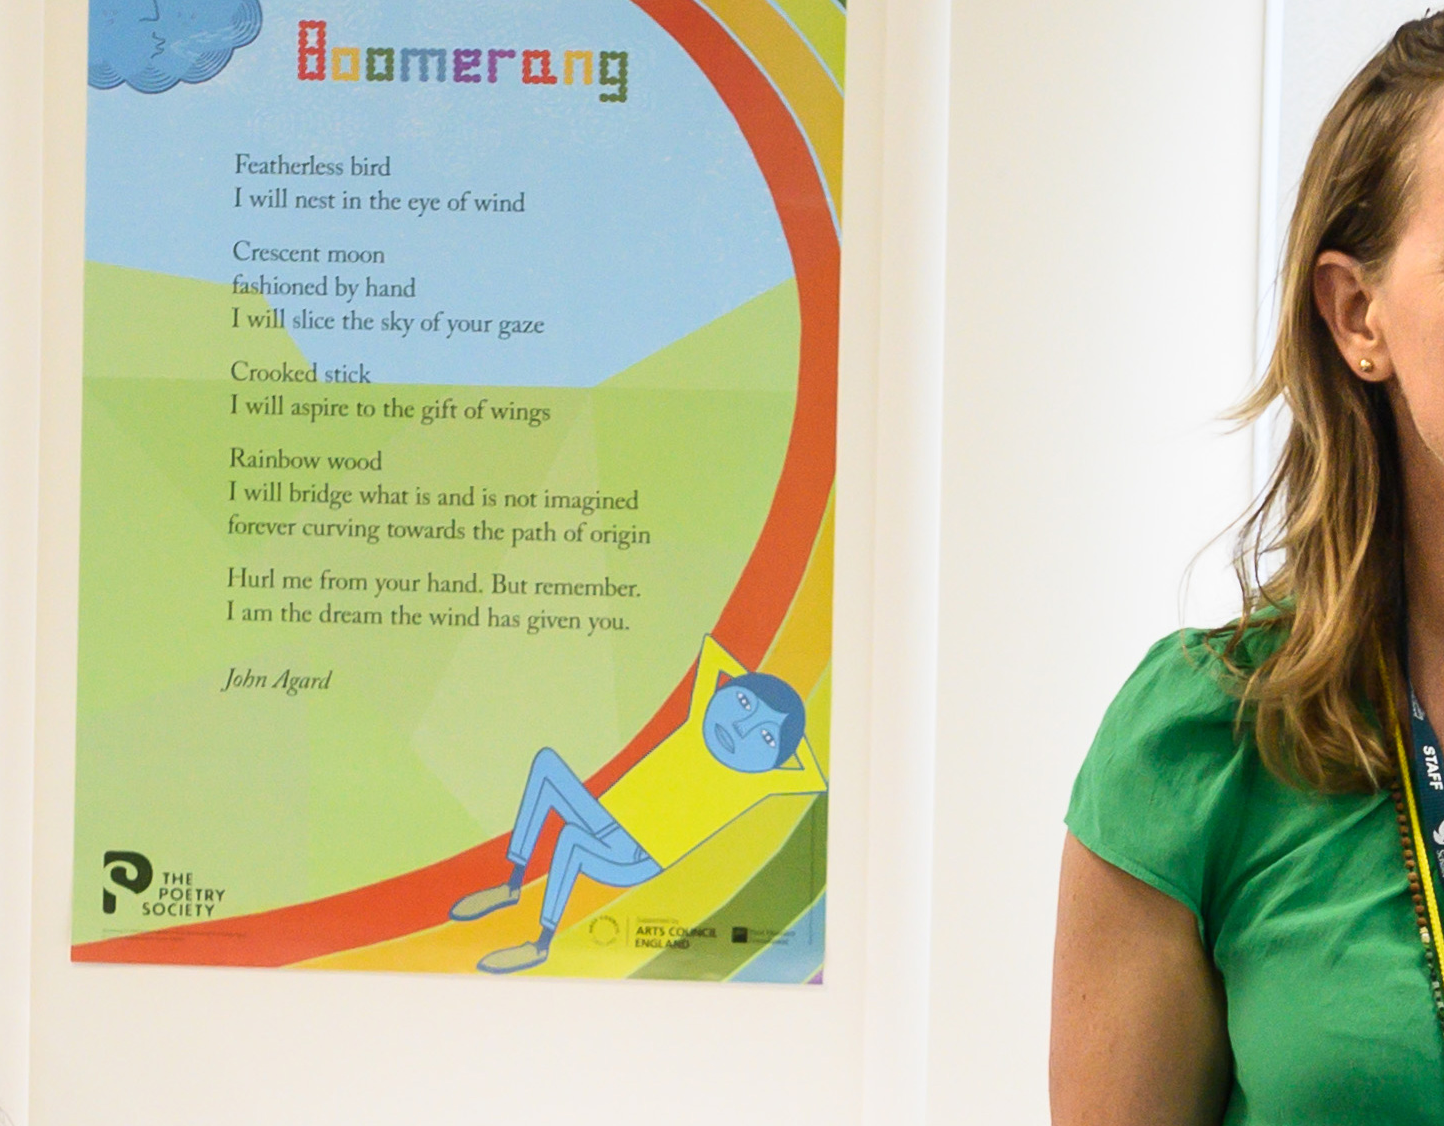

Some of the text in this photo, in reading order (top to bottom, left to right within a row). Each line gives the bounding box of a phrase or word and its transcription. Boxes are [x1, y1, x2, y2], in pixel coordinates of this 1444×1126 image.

[297, 19, 628, 103] Boomerang
[234, 153, 392, 177] Featherless bird
[234, 186, 526, 218] I will nest in the eye of wind
[232, 239, 385, 264] Crescent moon
[232, 273, 417, 304] fashioned by hand
[231, 306, 545, 341] I will slice the sky of your gaze
[230, 360, 372, 385] Crooked stick
[230, 393, 551, 428] I will aspire to the gift of wings
[229, 446, 383, 472] Rainbow wood
[229, 480, 639, 516] I will bridge what is and is not imagined
[227, 513, 651, 551] forever curving towards the path of origin
[227, 566, 641, 599] Hurl me from your hand. But remember.
[226, 599, 630, 637] I am the dream the wind has given you.
[220, 668, 333, 697] John Agard
[1423, 745, 1444, 791] STAFF
[163, 871, 193, 886] THE
[142, 902, 215, 917] SOCIETY
[159, 887, 226, 902] POETRY
[635, 939, 690, 949] ENGLAND
[636, 926, 717, 938] ARTS COUNCIL
